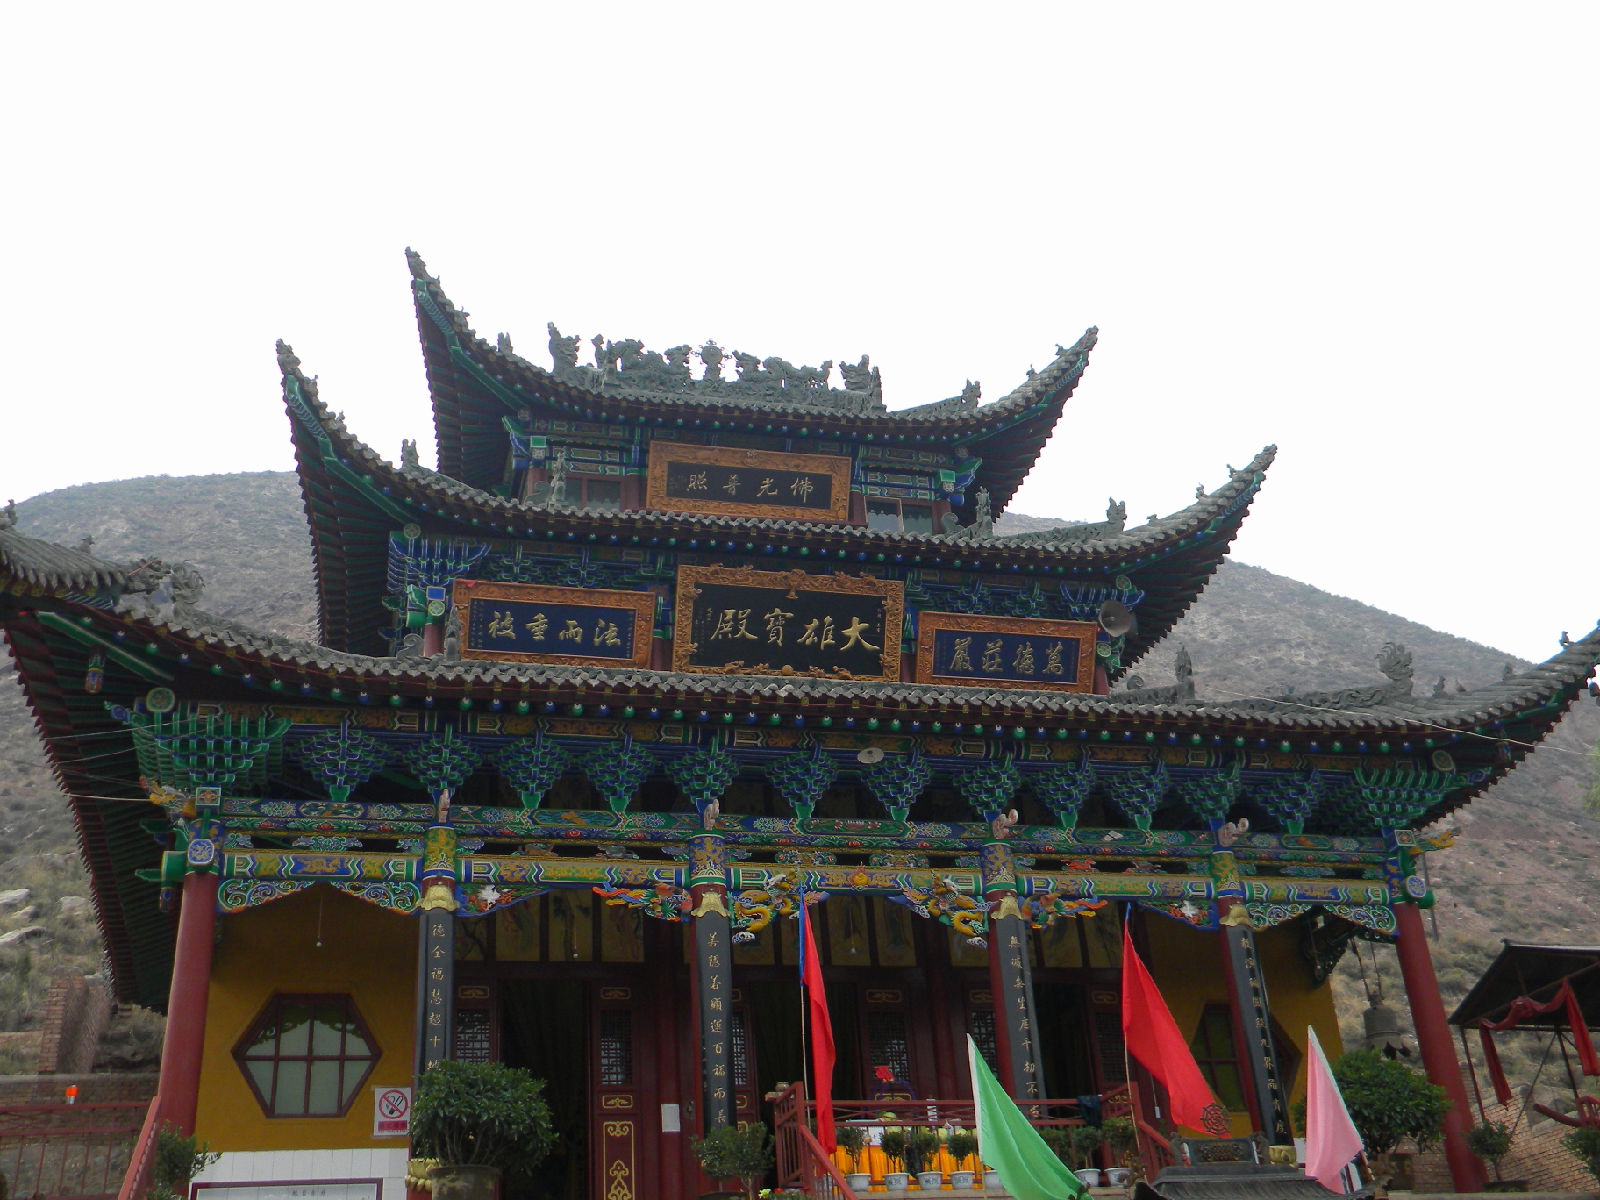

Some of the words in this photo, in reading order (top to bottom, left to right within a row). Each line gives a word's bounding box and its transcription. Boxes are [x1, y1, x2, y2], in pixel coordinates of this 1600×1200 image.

[686, 471, 815, 503] 佛光普照
[709, 607, 882, 651] 大雄寶殿
